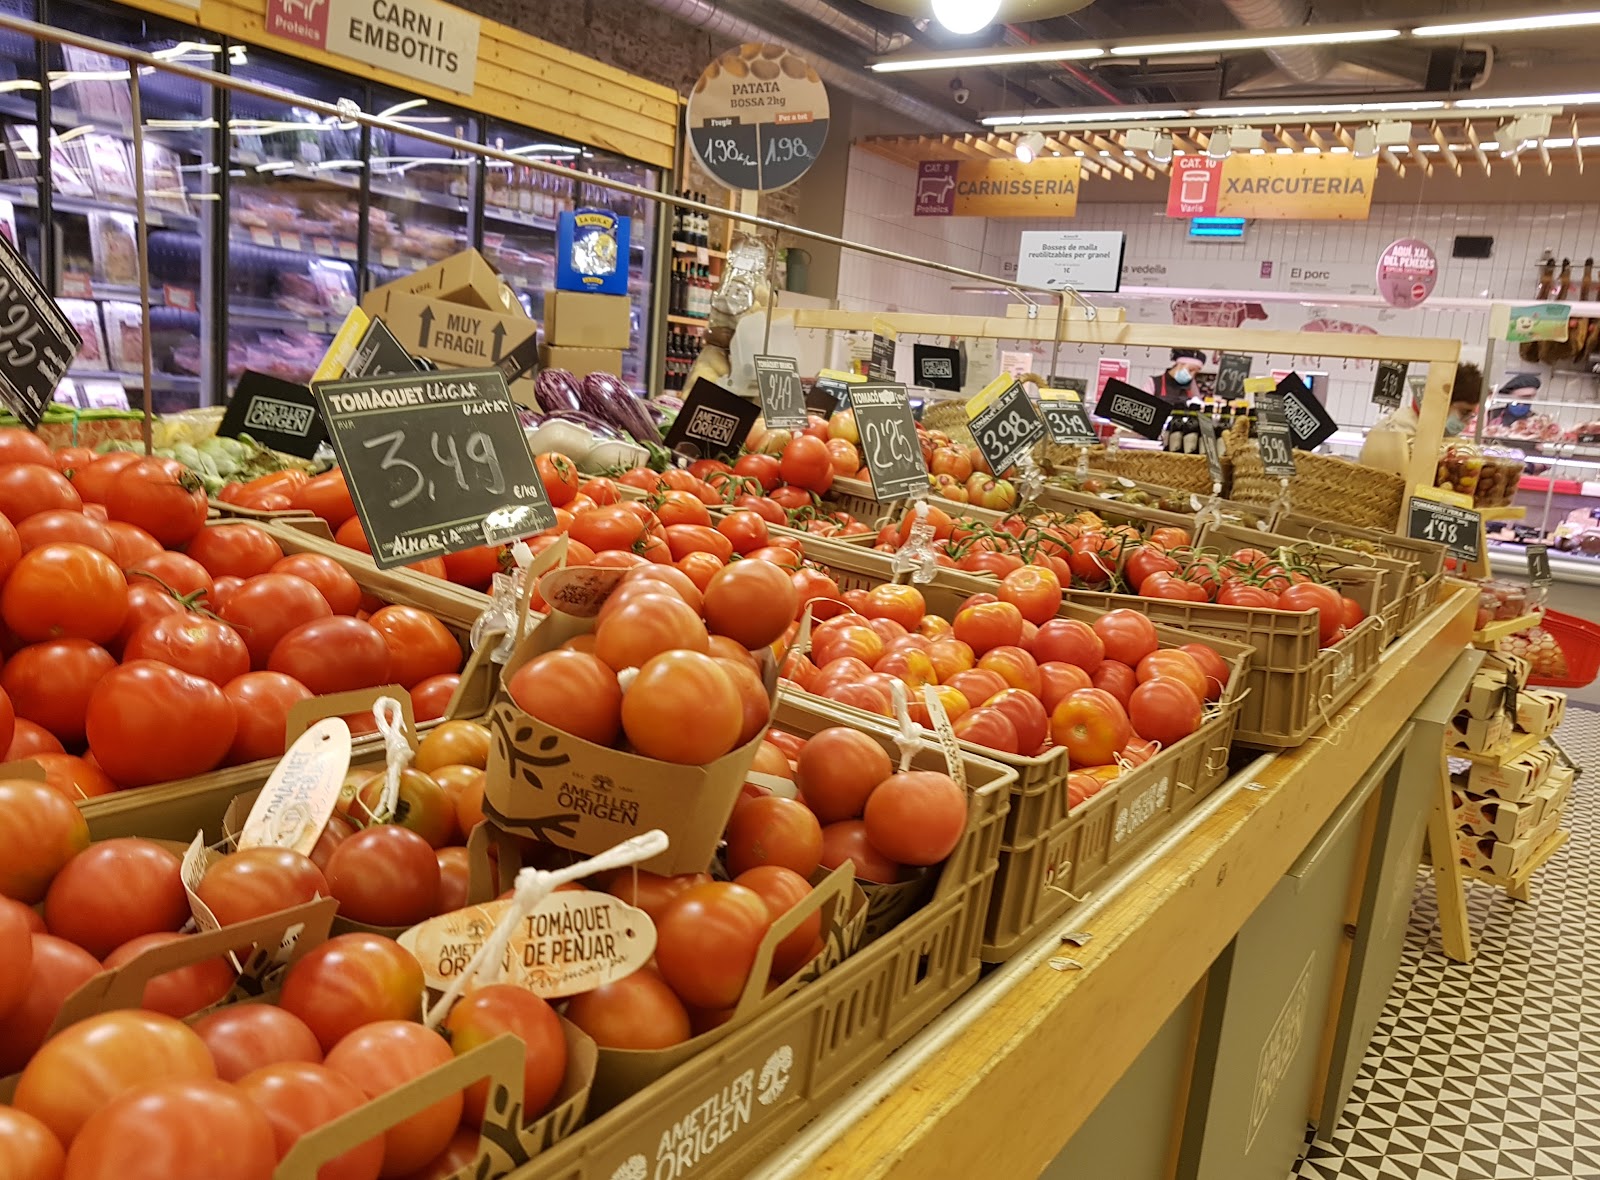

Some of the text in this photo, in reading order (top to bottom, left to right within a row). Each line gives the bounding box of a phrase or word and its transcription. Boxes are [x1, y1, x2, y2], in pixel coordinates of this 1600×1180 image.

[275, 15, 320, 41] Proteics
[373, 0, 444, 42] CARN I
[349, 18, 459, 74] EMBOTITS
[732, 82, 781, 95] PATATA
[730, 98, 765, 109] BOSSA
[1180, 158, 1217, 169] CAT. 10
[957, 179, 1075, 196] CARNISSERIA
[1225, 177, 1365, 194] XARCUTERIA
[1180, 203, 1203, 213] Varis
[1028, 250, 1110, 260] reutilitzables per granel
[1042, 243, 1098, 251] Bosses de malla
[1131, 264, 1167, 274] vedella
[1383, 255, 1398, 267] DEL
[1290, 268, 1330, 280] El porc
[447, 313, 481, 334] MUY
[434, 331, 487, 358] FRAGIL
[924, 366, 950, 375] ORIGEN
[255, 400, 309, 420] AMETLLER
[328, 387, 423, 414] TOMÀQUET
[1117, 398, 1152, 414] AMETLLER
[251, 409, 306, 432] ORIGEN
[696, 410, 735, 430] AMETLLER
[1115, 403, 1151, 422] ORIGEN
[691, 420, 732, 442] ORIGEN
[1048, 412, 1087, 435] 3,49
[983, 410, 1031, 460] 3,98
[363, 430, 506, 509] 3,49
[1423, 519, 1458, 543] 1'98
[560, 782, 640, 812] AMETLLER
[557, 792, 638, 826] ORIGEN
[526, 902, 612, 943] TOMÀQUET
[524, 934, 616, 967] DE PENJAR
[656, 1068, 755, 1161] AMETLLER
[653, 1086, 753, 1180] ORIGEN
